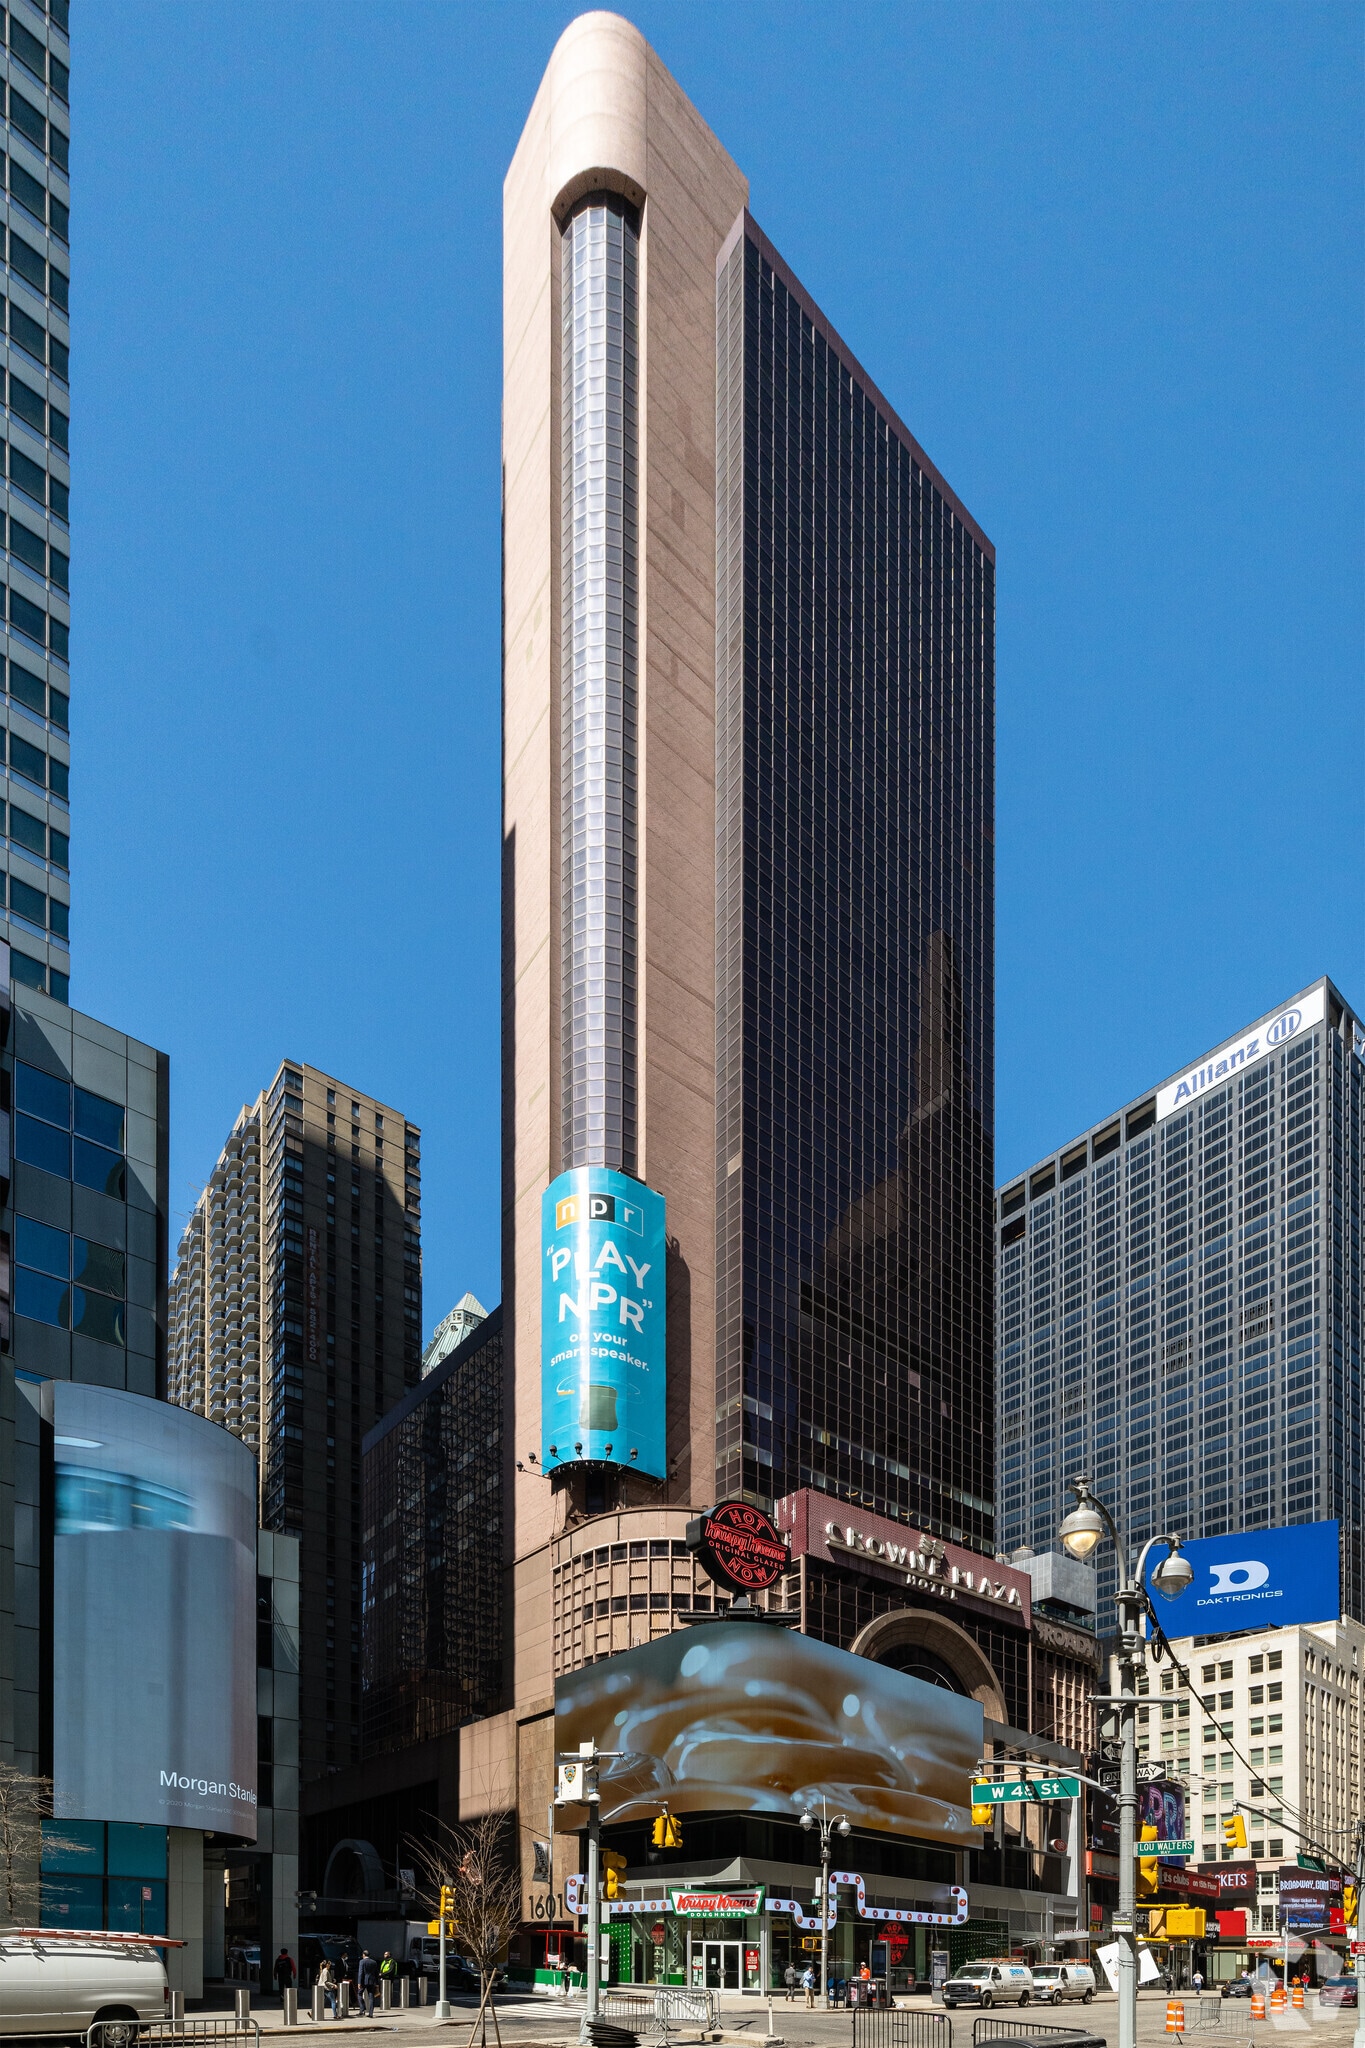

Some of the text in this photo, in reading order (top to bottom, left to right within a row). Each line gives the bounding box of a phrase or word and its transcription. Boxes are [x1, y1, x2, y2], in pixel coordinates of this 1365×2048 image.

[1173, 1039, 1260, 1106] Allianz
[561, 1199, 635, 1223] npr
[593, 1332, 628, 1346] your
[590, 1347, 650, 1372] speaker.
[728, 1509, 766, 1531] HOT
[708, 1540, 785, 1571] ORIGINAL GLAZED
[825, 1521, 1023, 1607] CROWNE PLAZA
[727, 1557, 768, 1582] NOW
[906, 1574, 958, 1600] HOTEL
[1197, 1590, 1283, 1606] DAKTRONICS
[160, 1770, 227, 1796] Morgan
[1105, 1771, 1120, 1781] ON
[991, 1782, 1060, 1799] W 48 St
[1139, 1841, 1193, 1852] LOU WALTERS
[534, 1843, 548, 1879] MORMON
[1173, 1873, 1190, 1886] clubs
[1213, 1873, 1247, 1887] KETS
[1280, 1880, 1329, 1891] BROADWAY.COM
[528, 1893, 563, 1919] 1601
[677, 1894, 758, 1911] Krispy Kreme
